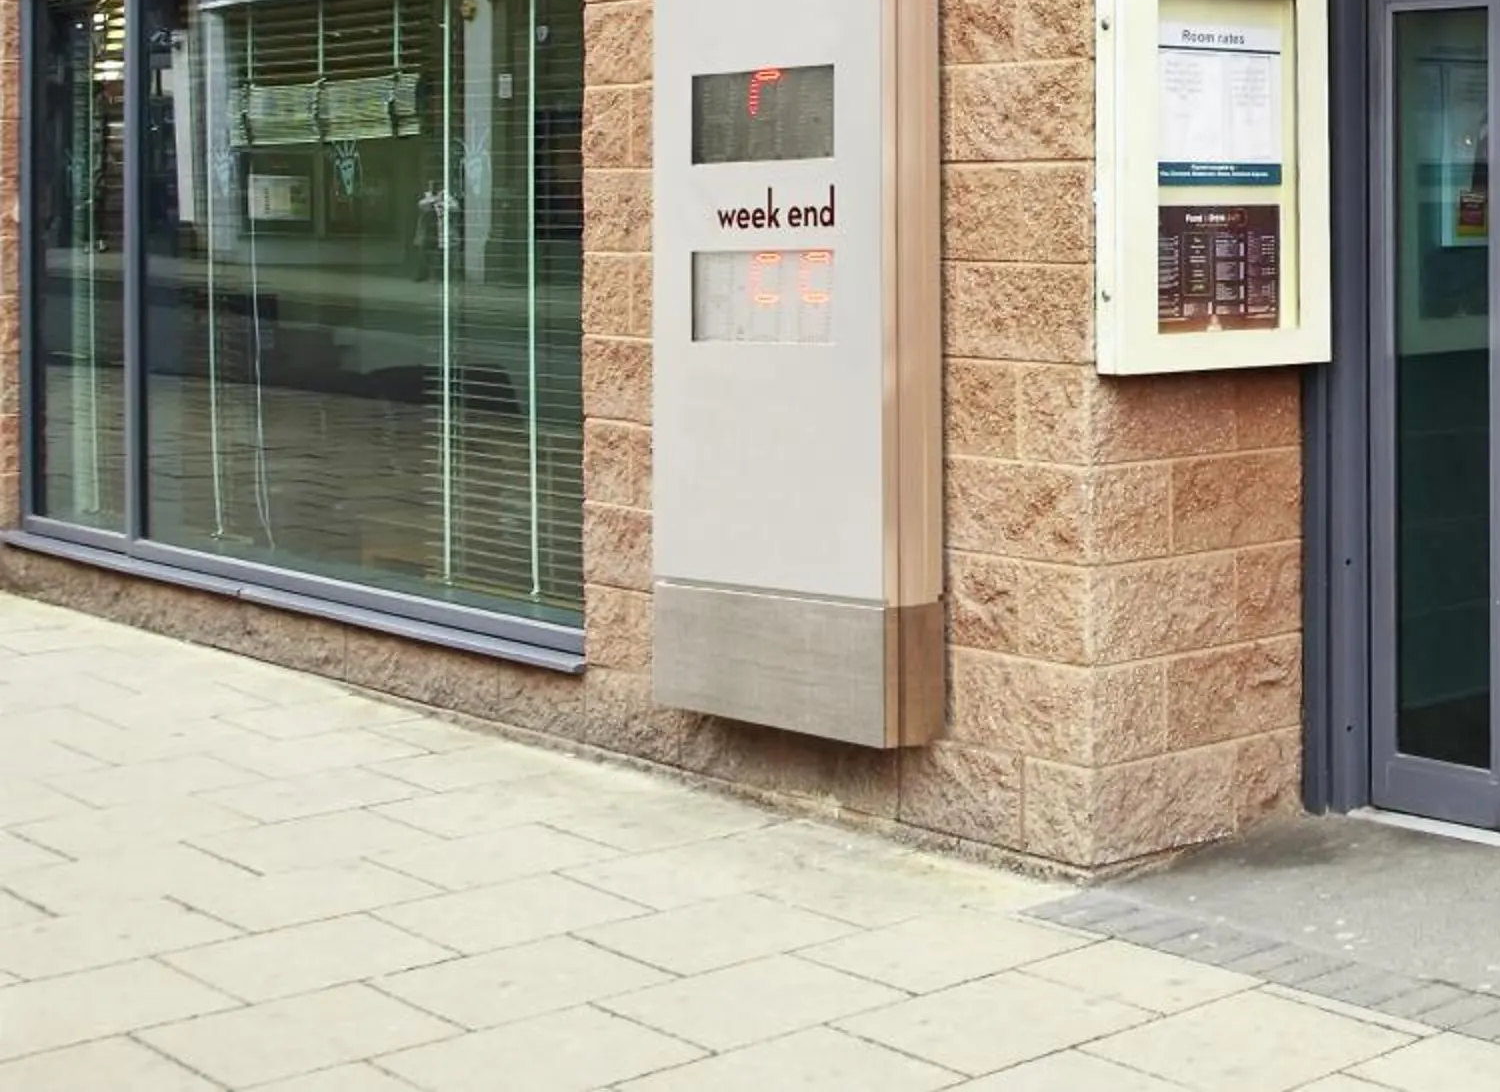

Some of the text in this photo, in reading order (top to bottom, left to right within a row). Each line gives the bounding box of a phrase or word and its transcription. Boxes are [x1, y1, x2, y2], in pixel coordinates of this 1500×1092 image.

[1181, 29, 1247, 46] Room rates
[717, 183, 836, 230] week end
